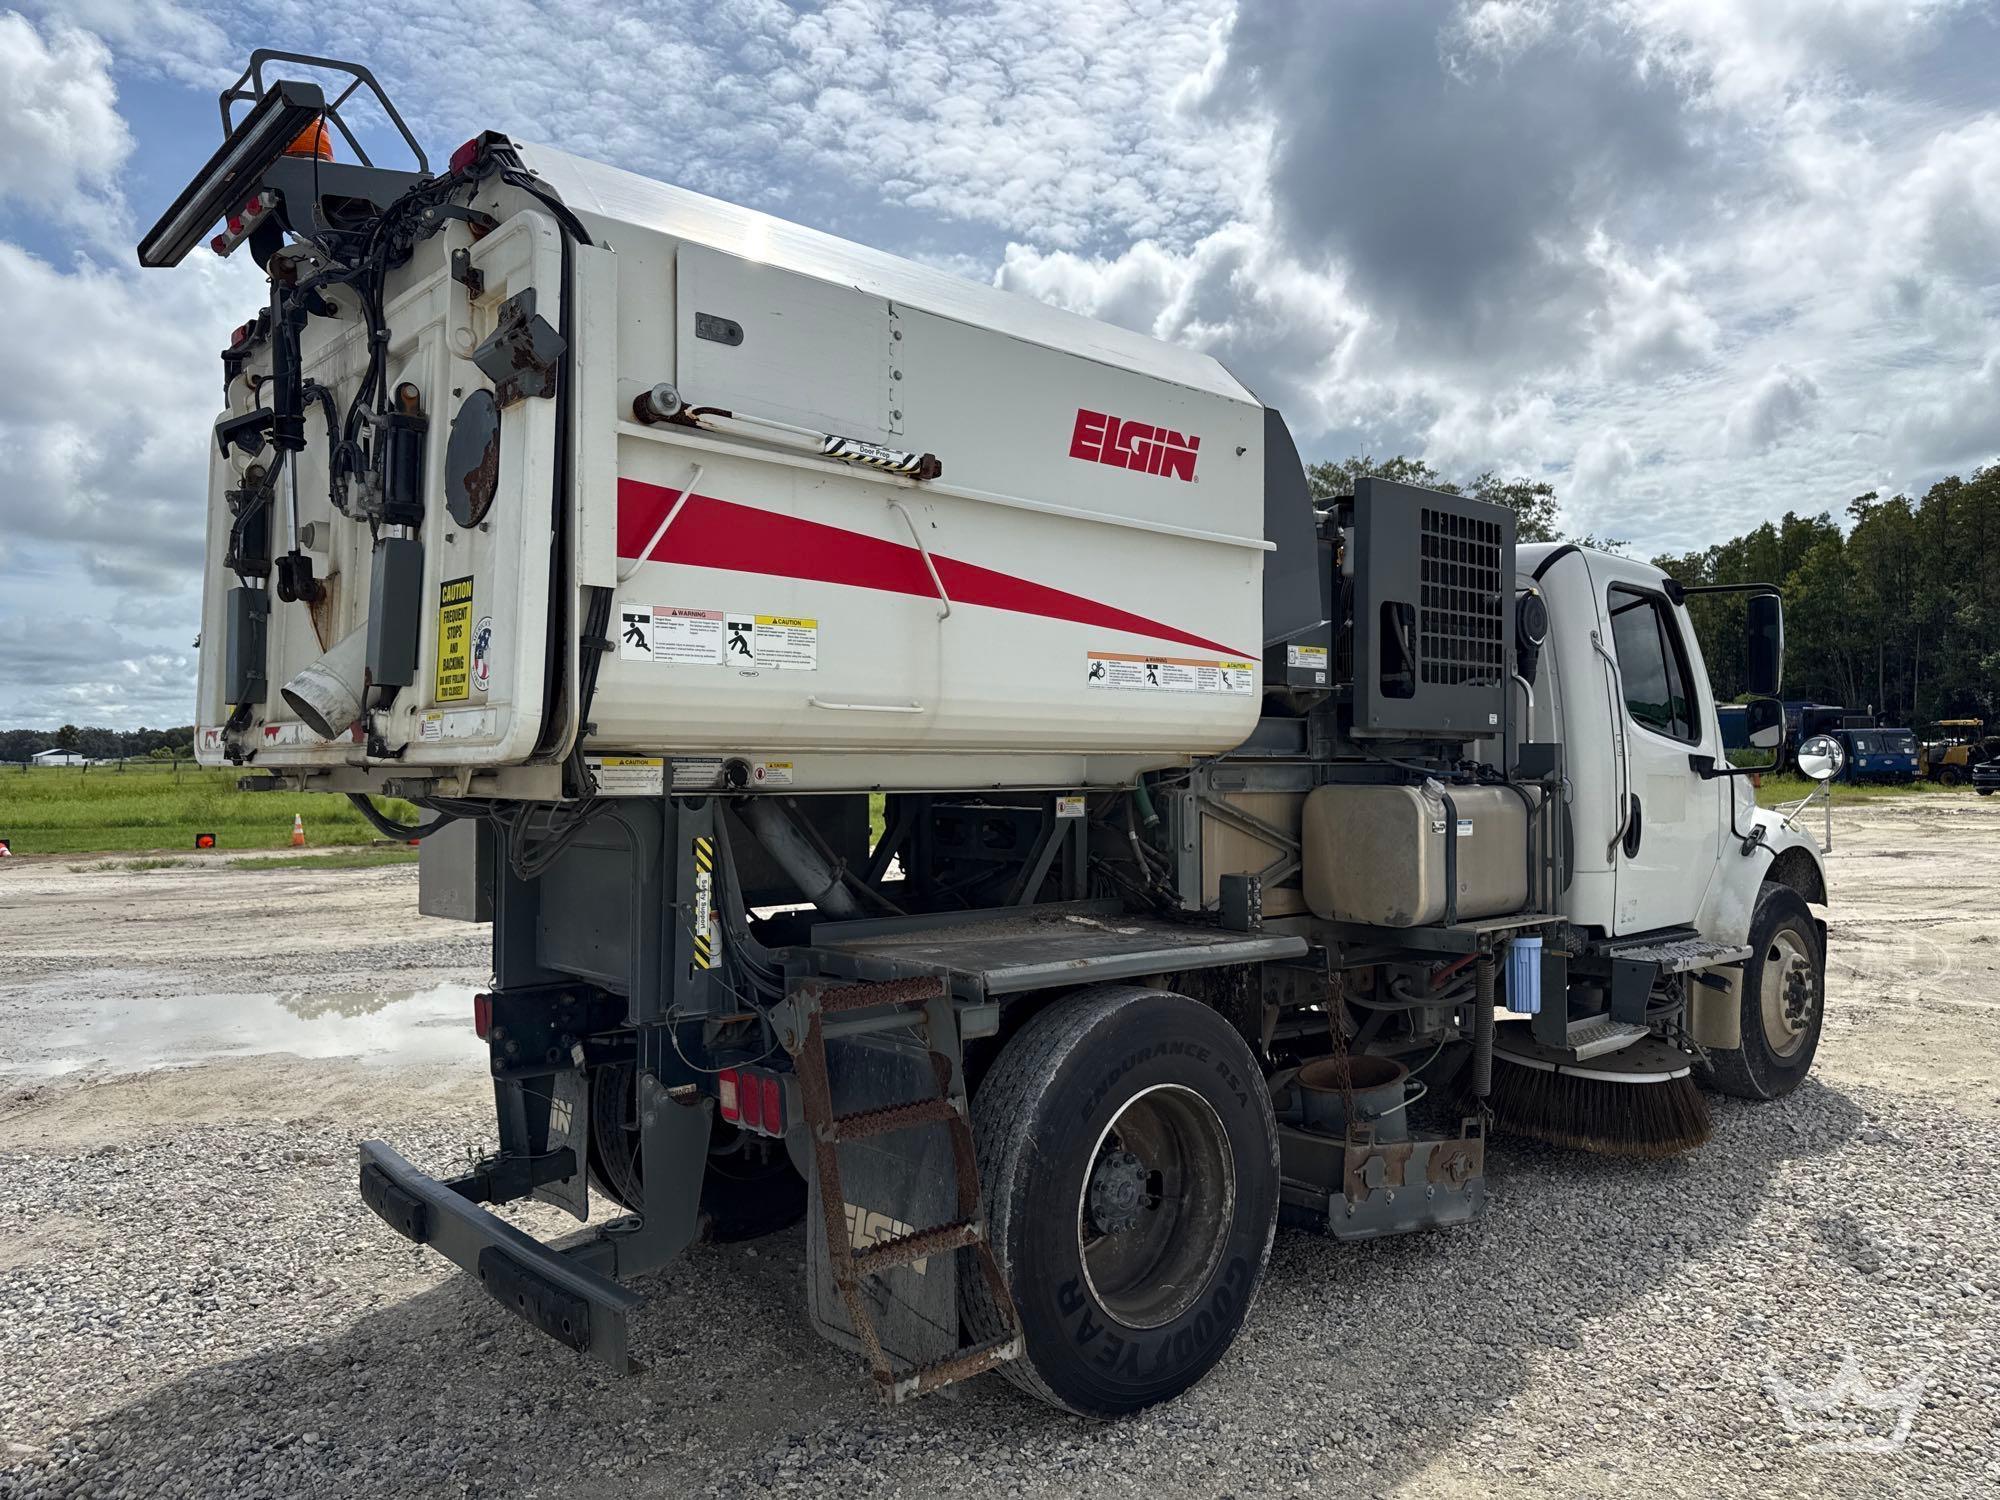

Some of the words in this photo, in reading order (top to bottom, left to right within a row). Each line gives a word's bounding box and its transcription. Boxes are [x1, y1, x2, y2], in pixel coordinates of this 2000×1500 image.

[860, 446, 876, 456] Door
[876, 448, 890, 460] Prop
[1069, 408, 1200, 483] ELGIN
[442, 580, 472, 603] CAUTION
[443, 606, 468, 624] FREQUENT
[678, 609, 706, 618] WARNING
[778, 618, 802, 626] CAUTION
[447, 625, 463, 640] STOPS
[449, 642, 459, 654] AND
[443, 656, 464, 672] BACKING
[1081, 1041, 1211, 1120] ENDURANCE
[1216, 1062, 1248, 1109] RSA
[1057, 1256, 1248, 1377] GOODYEAR
